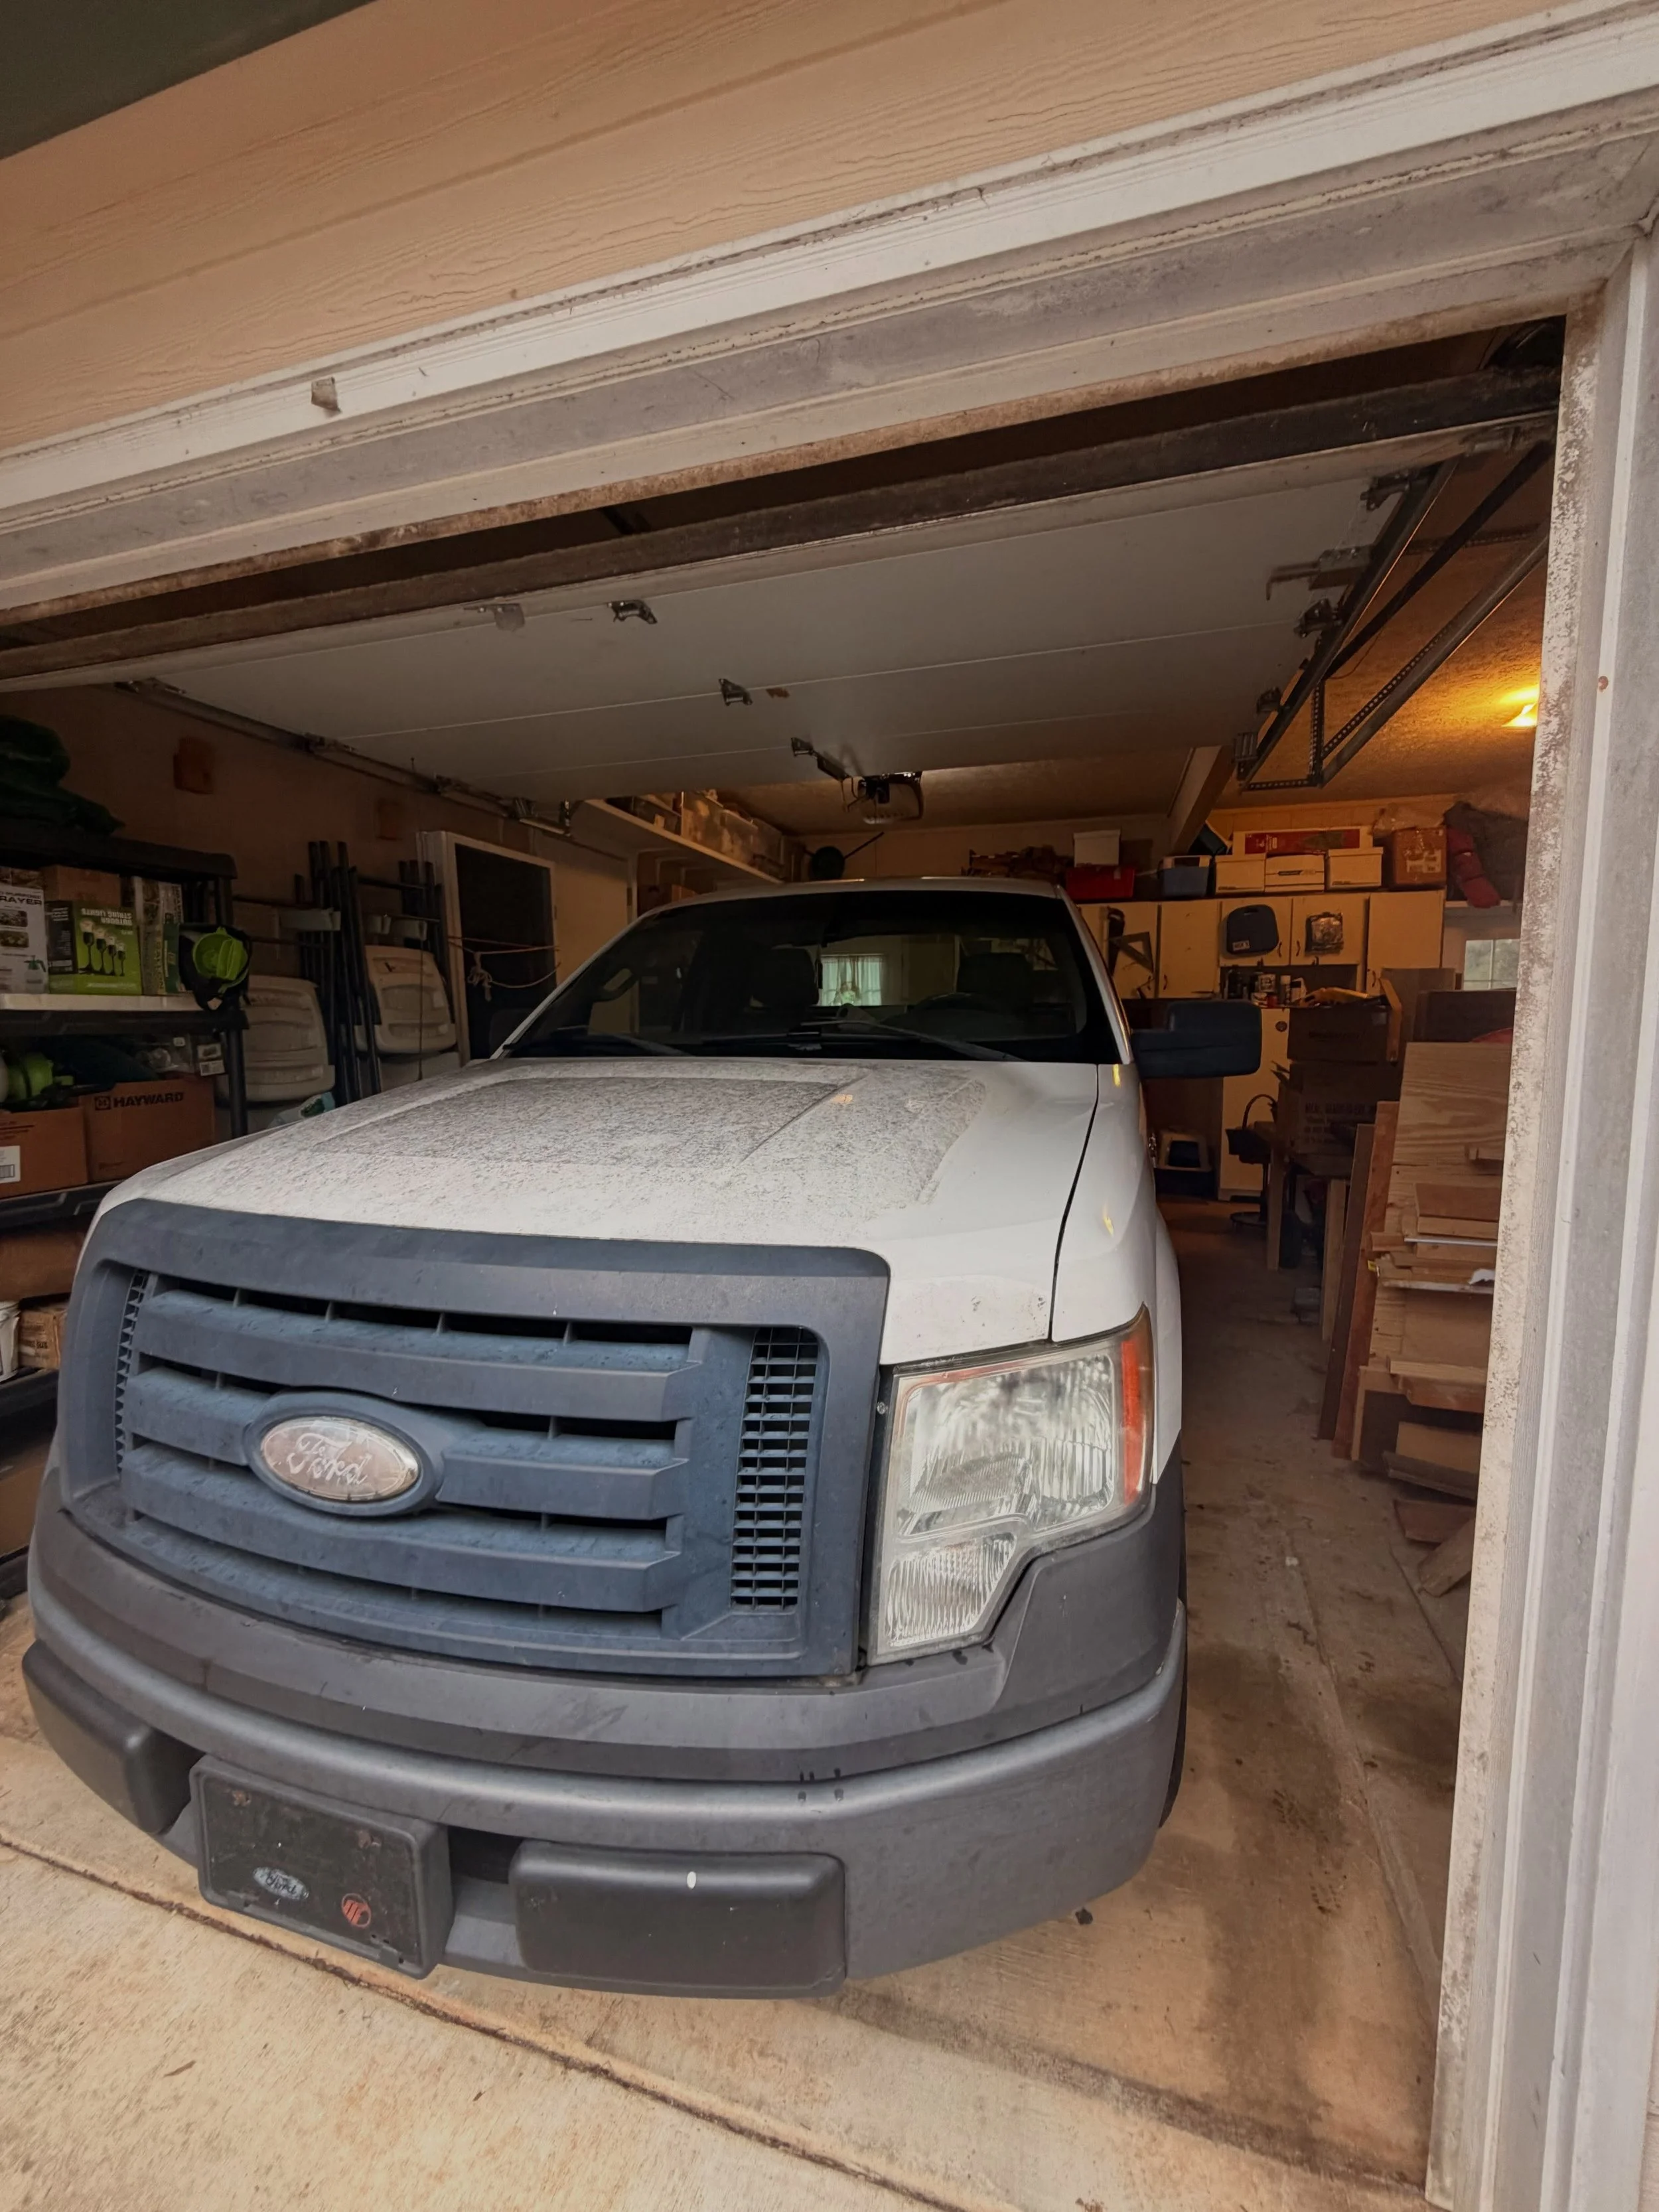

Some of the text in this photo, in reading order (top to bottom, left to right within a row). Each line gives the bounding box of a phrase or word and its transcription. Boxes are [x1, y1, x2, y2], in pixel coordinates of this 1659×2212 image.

[113, 1092, 184, 1108] HAYWARD
[286, 1432, 372, 1487] Ford
[265, 1872, 297, 1895] Ford
